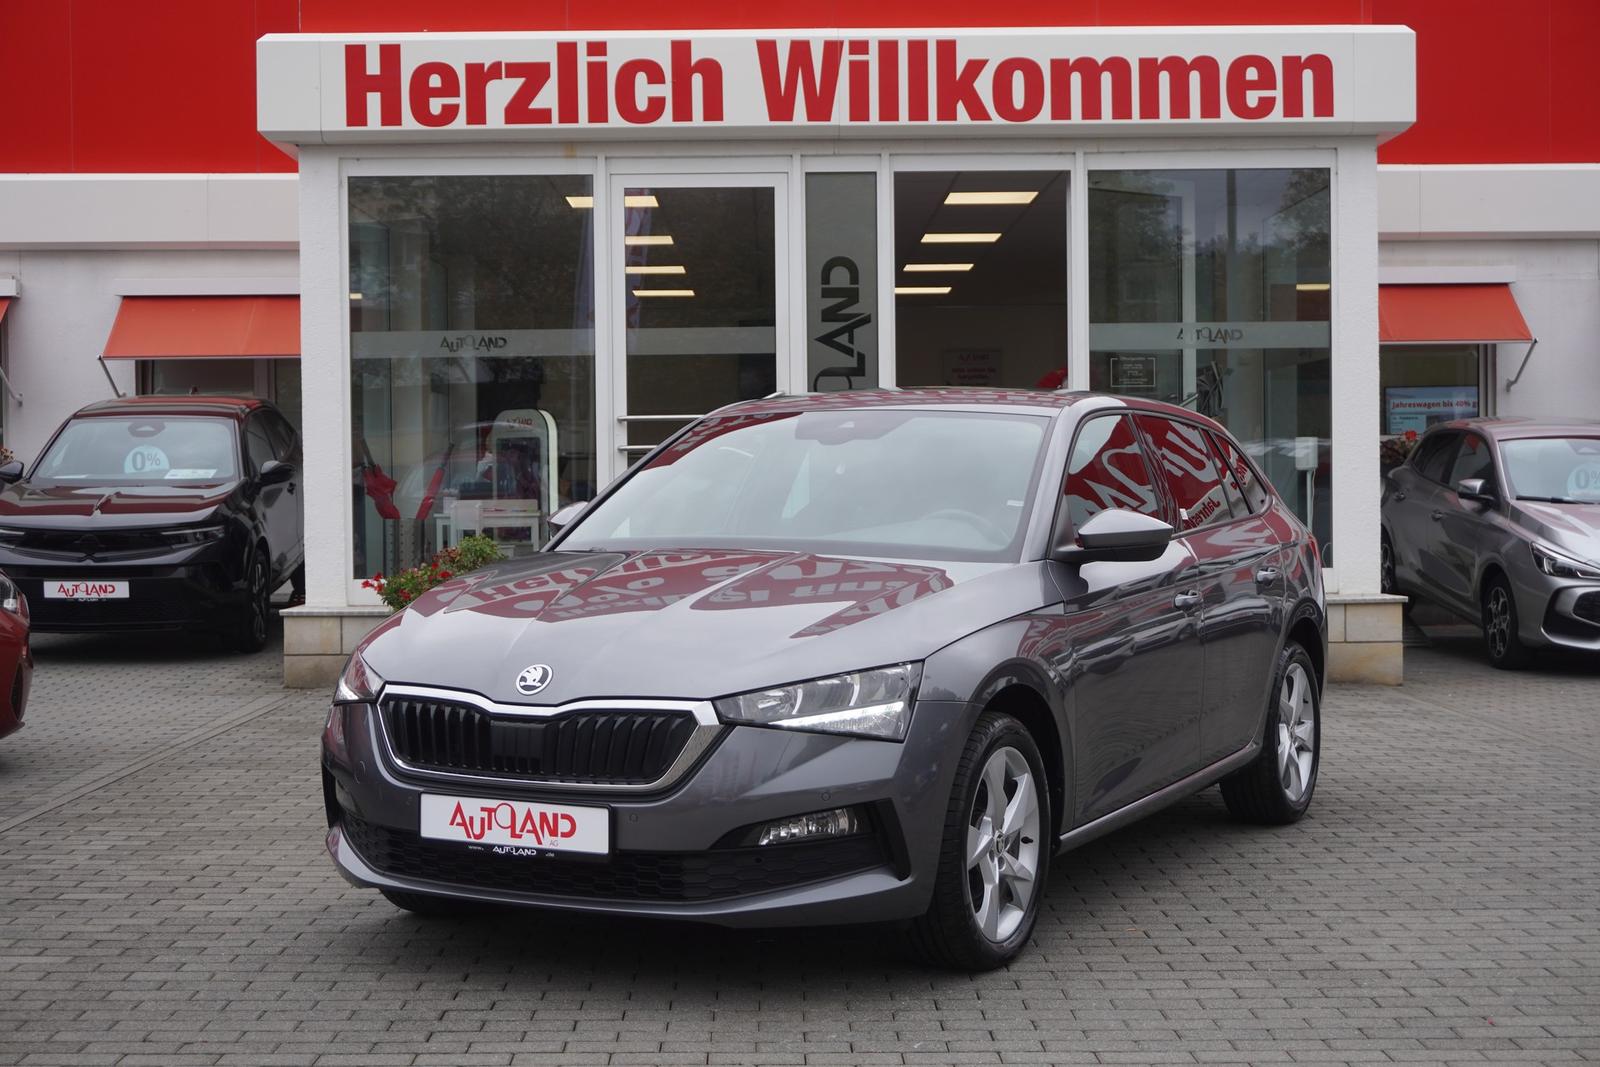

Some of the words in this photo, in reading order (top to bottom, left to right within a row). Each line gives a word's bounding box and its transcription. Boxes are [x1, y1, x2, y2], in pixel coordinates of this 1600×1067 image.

[344, 40, 724, 127] Herzlich
[756, 38, 1334, 122] Willkommen
[440, 335, 507, 352] AUTOLAND
[1177, 327, 1243, 344] ATOLAND
[132, 451, 161, 471] 0%
[58, 582, 116, 597] AUTOLAND
[449, 800, 577, 846] AUTOLAND
[493, 846, 537, 856] AUTOLAND
